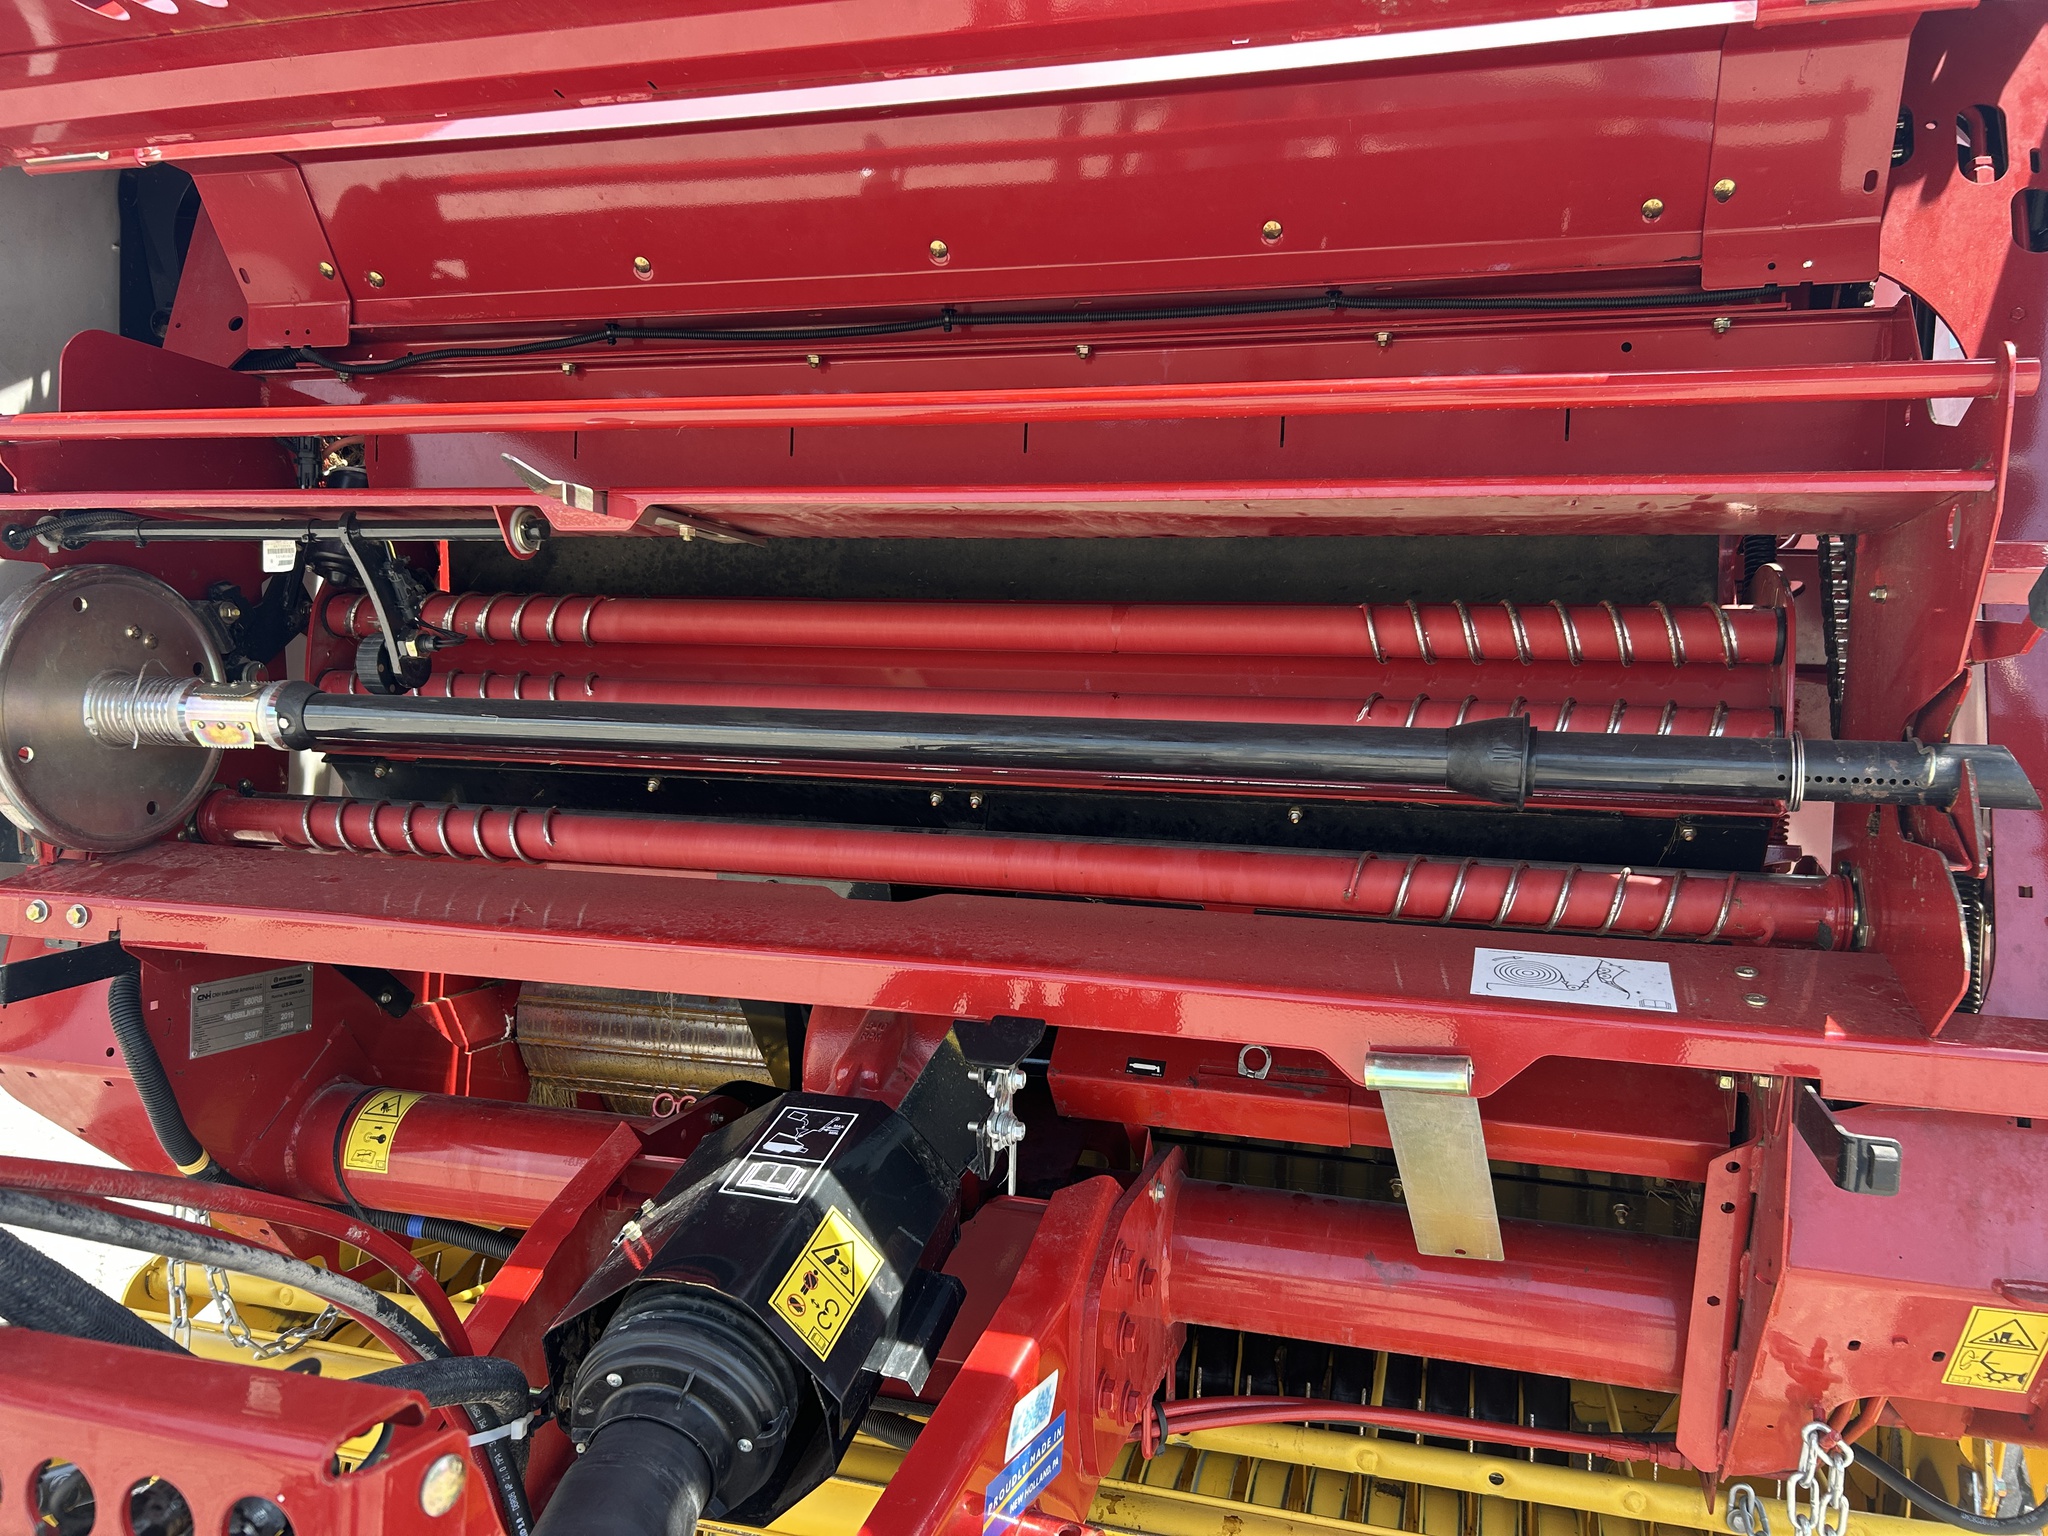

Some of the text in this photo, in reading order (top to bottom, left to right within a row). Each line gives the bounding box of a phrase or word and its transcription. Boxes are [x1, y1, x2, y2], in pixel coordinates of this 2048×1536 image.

[477, 1417, 488, 1430] PSI
[988, 1425, 1062, 1516] PROUDLY MADE IN
[1009, 1456, 1059, 1514] NEW HOLLAND, PA
